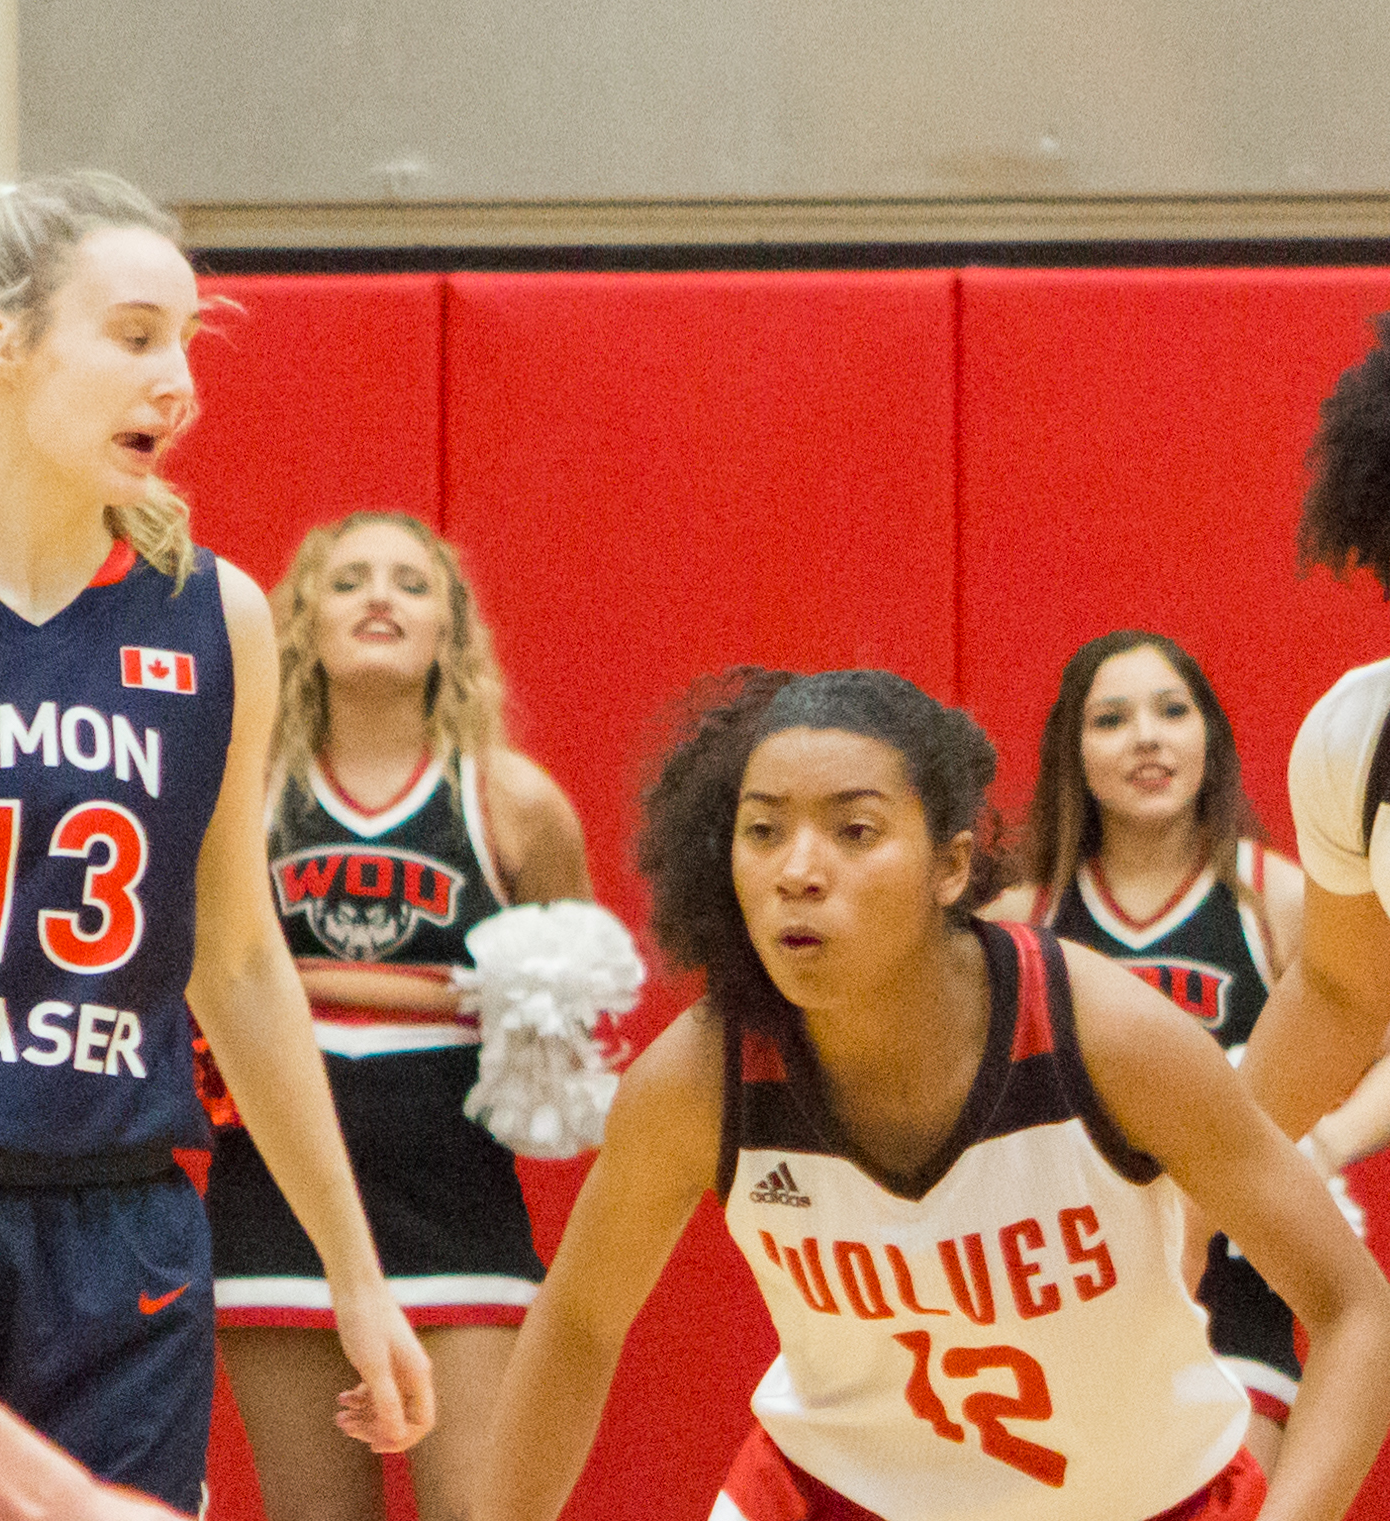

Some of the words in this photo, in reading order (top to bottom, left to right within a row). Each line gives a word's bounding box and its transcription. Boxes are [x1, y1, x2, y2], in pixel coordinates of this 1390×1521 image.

[282, 854, 453, 916] WOU
[749, 1191, 812, 1208] adidas
[758, 1204, 1117, 1326] WOLVES
[892, 1330, 1067, 1488] 12
